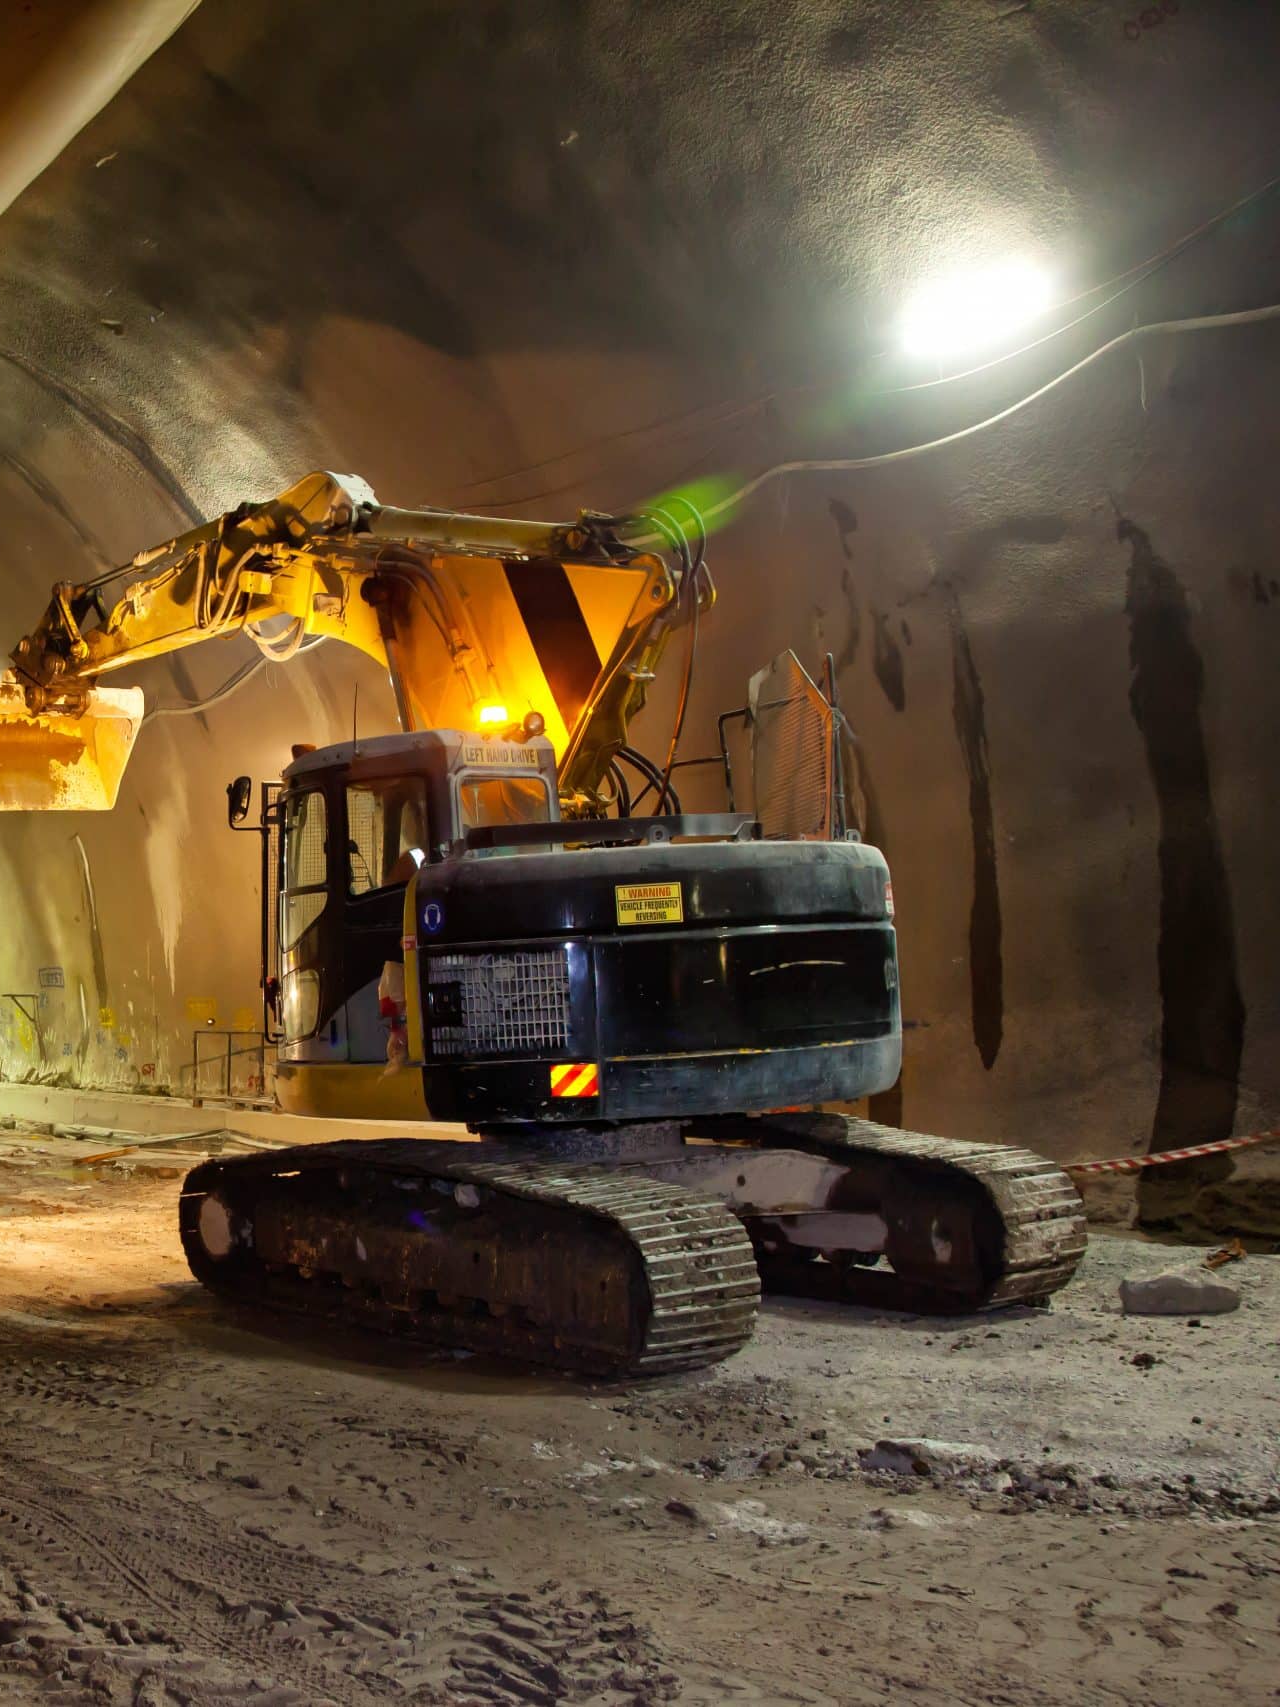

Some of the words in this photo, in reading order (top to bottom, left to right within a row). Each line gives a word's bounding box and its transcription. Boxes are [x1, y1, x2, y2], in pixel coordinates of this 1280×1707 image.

[465, 747, 484, 762] LEFT
[487, 747, 508, 762] HAND
[511, 748, 536, 764] DRIVE
[628, 887, 672, 898] WARNING
[620, 901, 642, 911] VEHICLE
[644, 899, 678, 910] FREQUENTLY
[635, 911, 667, 921] REVERSING
